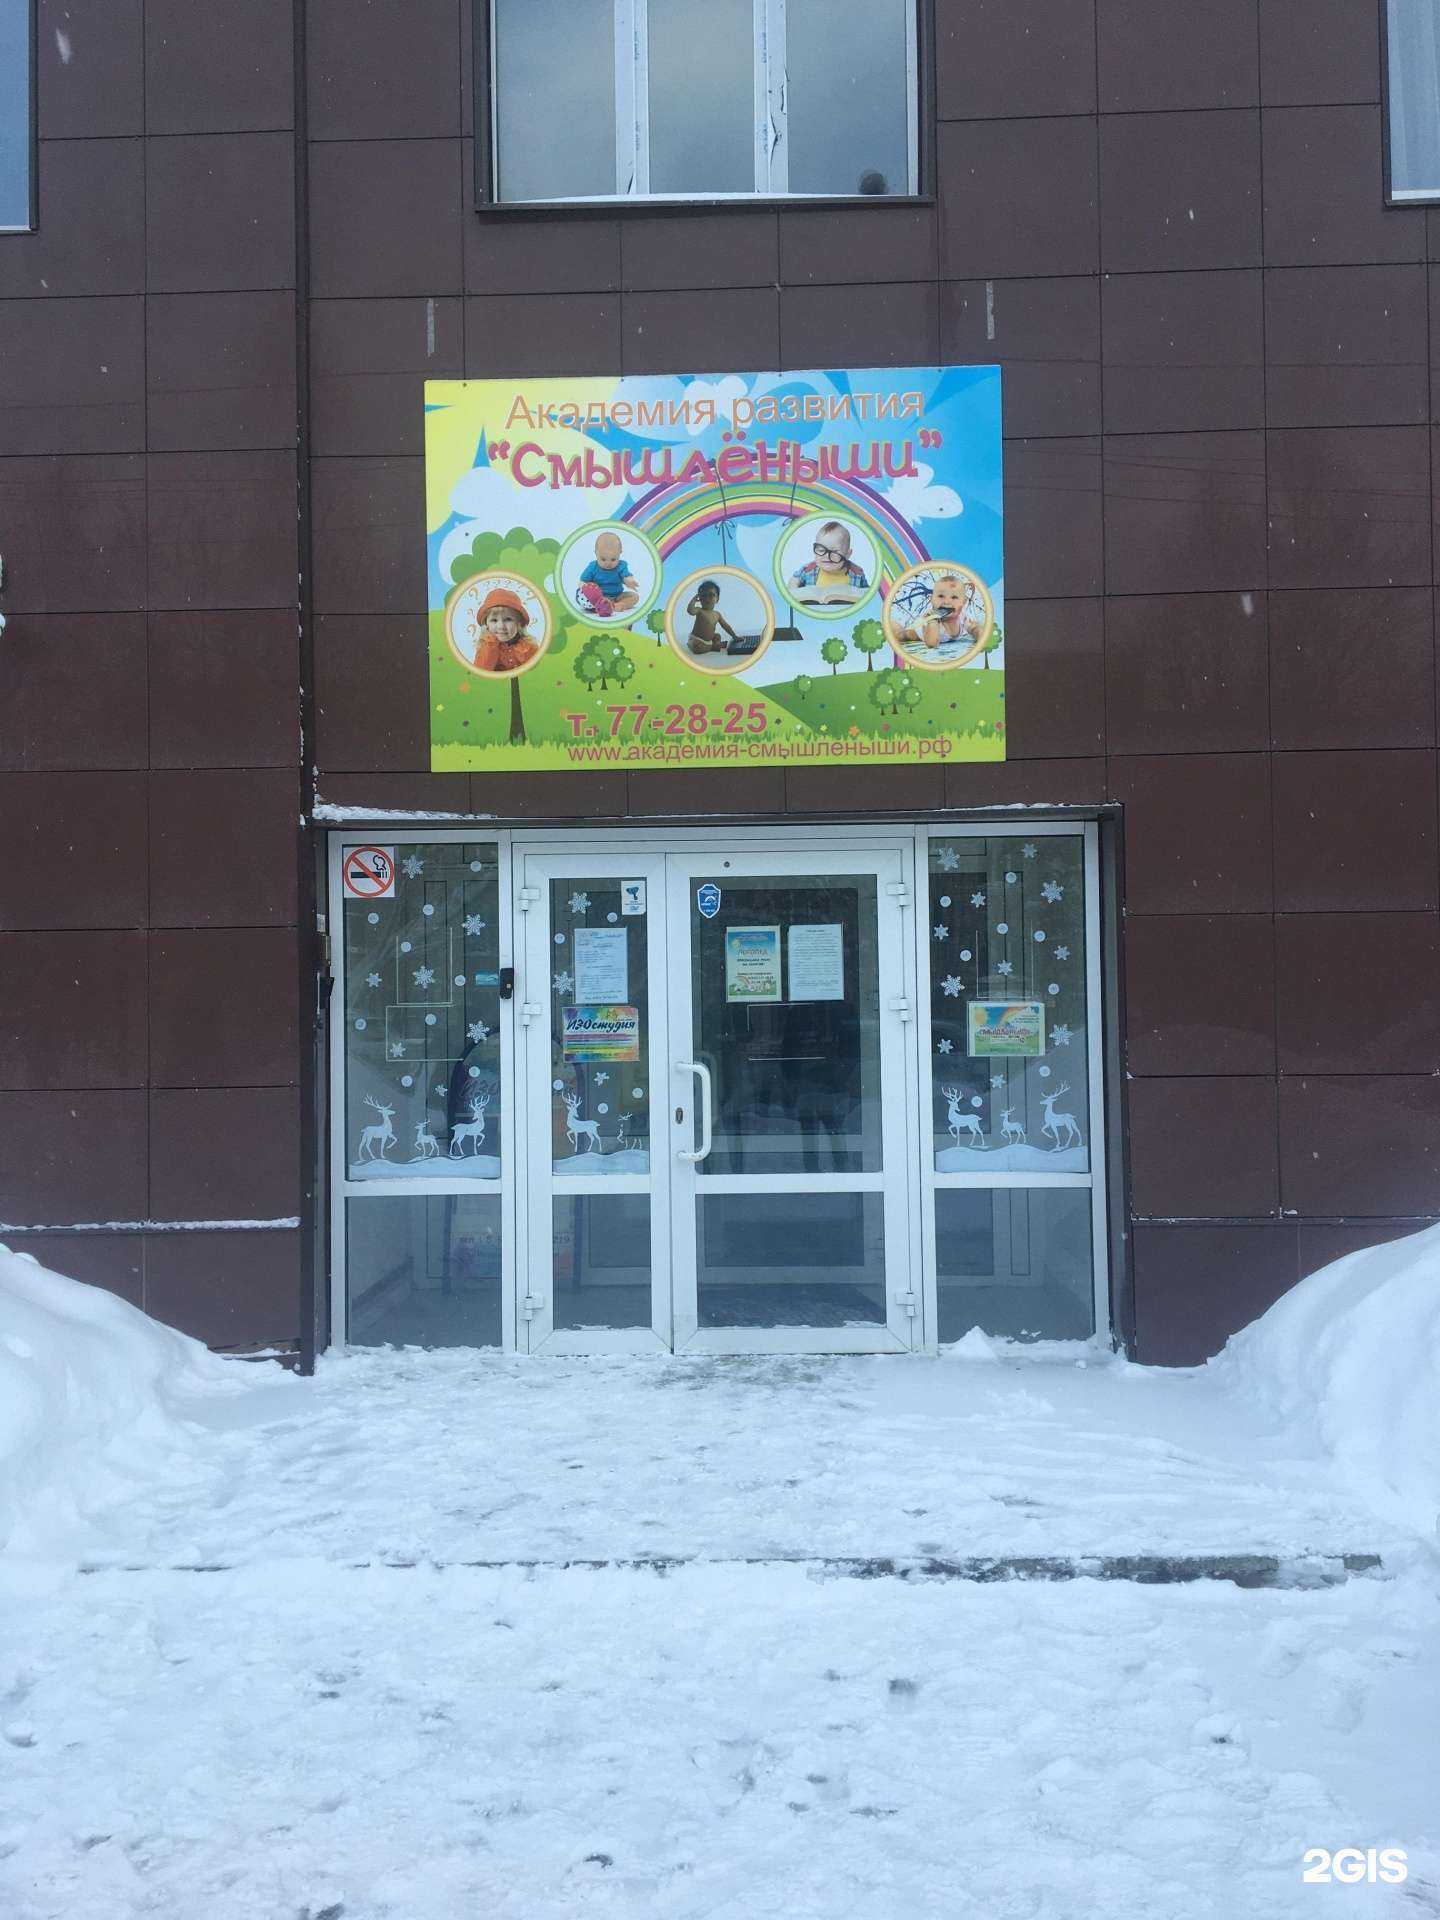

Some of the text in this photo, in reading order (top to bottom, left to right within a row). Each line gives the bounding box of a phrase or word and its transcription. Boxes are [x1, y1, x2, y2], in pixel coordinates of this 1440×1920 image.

[504, 391, 924, 433] Академия развития
[566, 702, 768, 737] т. 77-28-25
[567, 737, 953, 763] www.академия-смышленыши.рф
